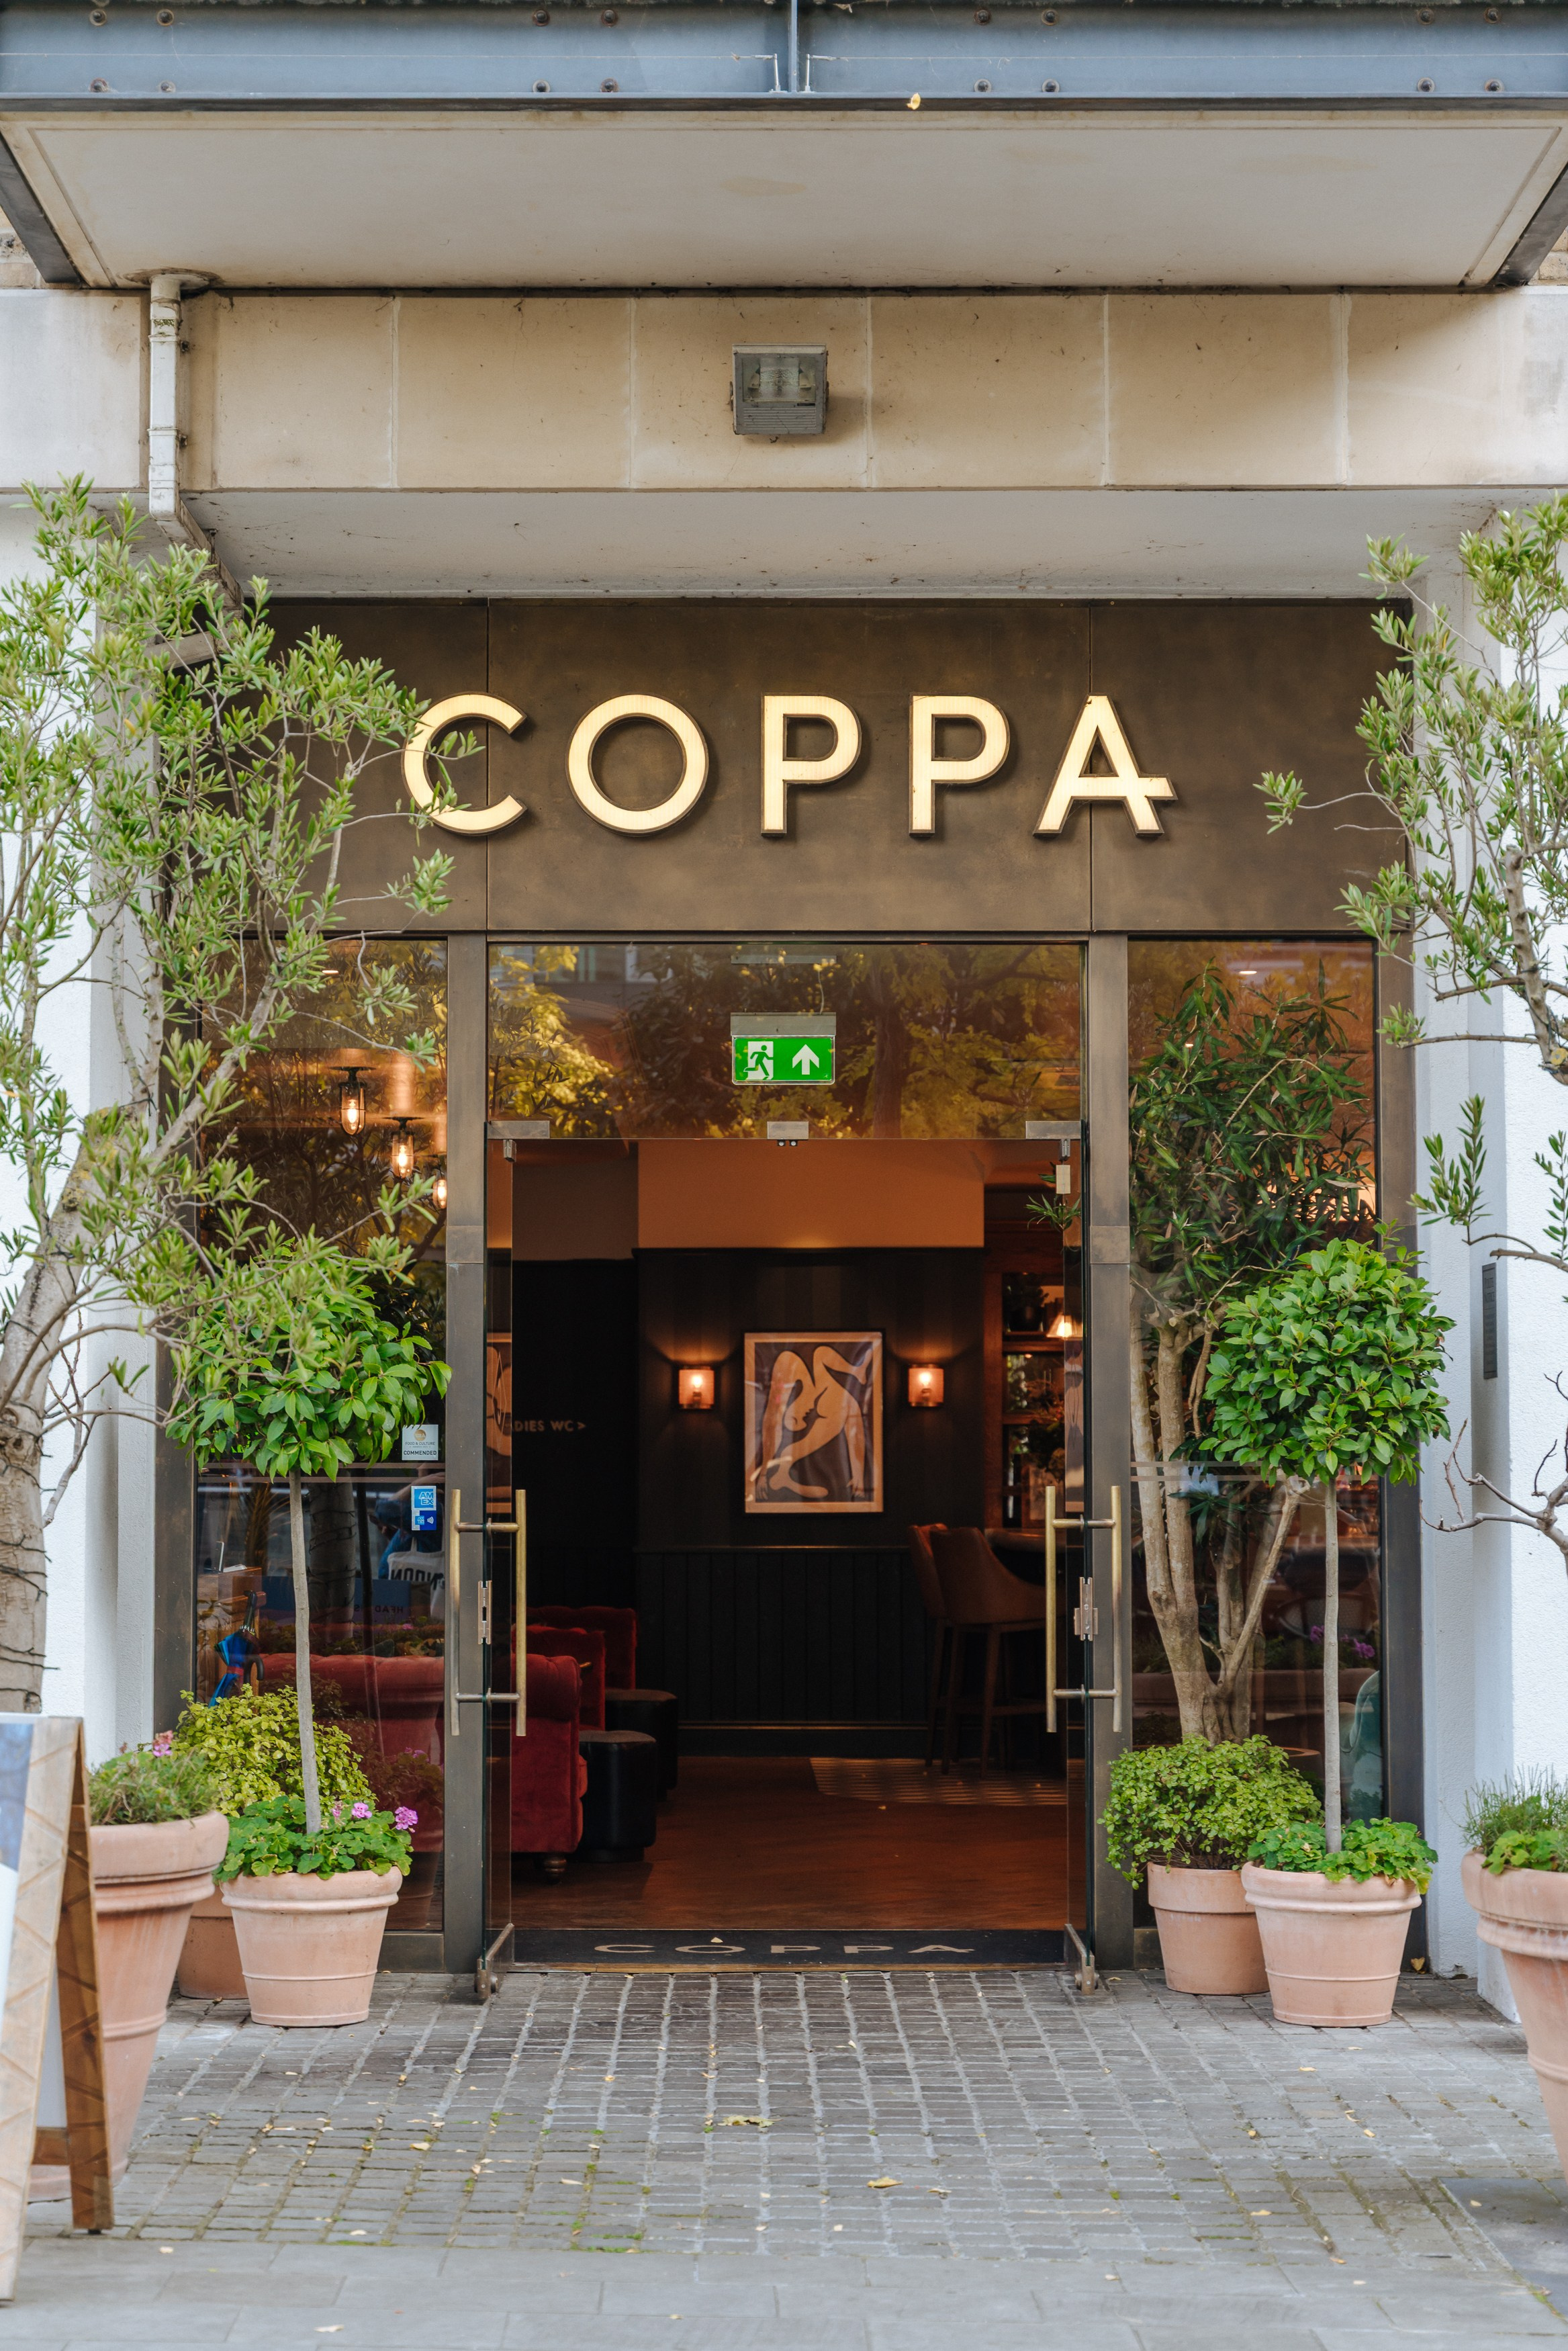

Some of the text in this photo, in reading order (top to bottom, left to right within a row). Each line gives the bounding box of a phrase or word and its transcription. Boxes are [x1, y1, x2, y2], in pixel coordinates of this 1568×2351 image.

[402, 691, 1177, 837] COPPA
[512, 1420, 573, 1432] DIES WC
[594, 1944, 975, 1954] COPPA
